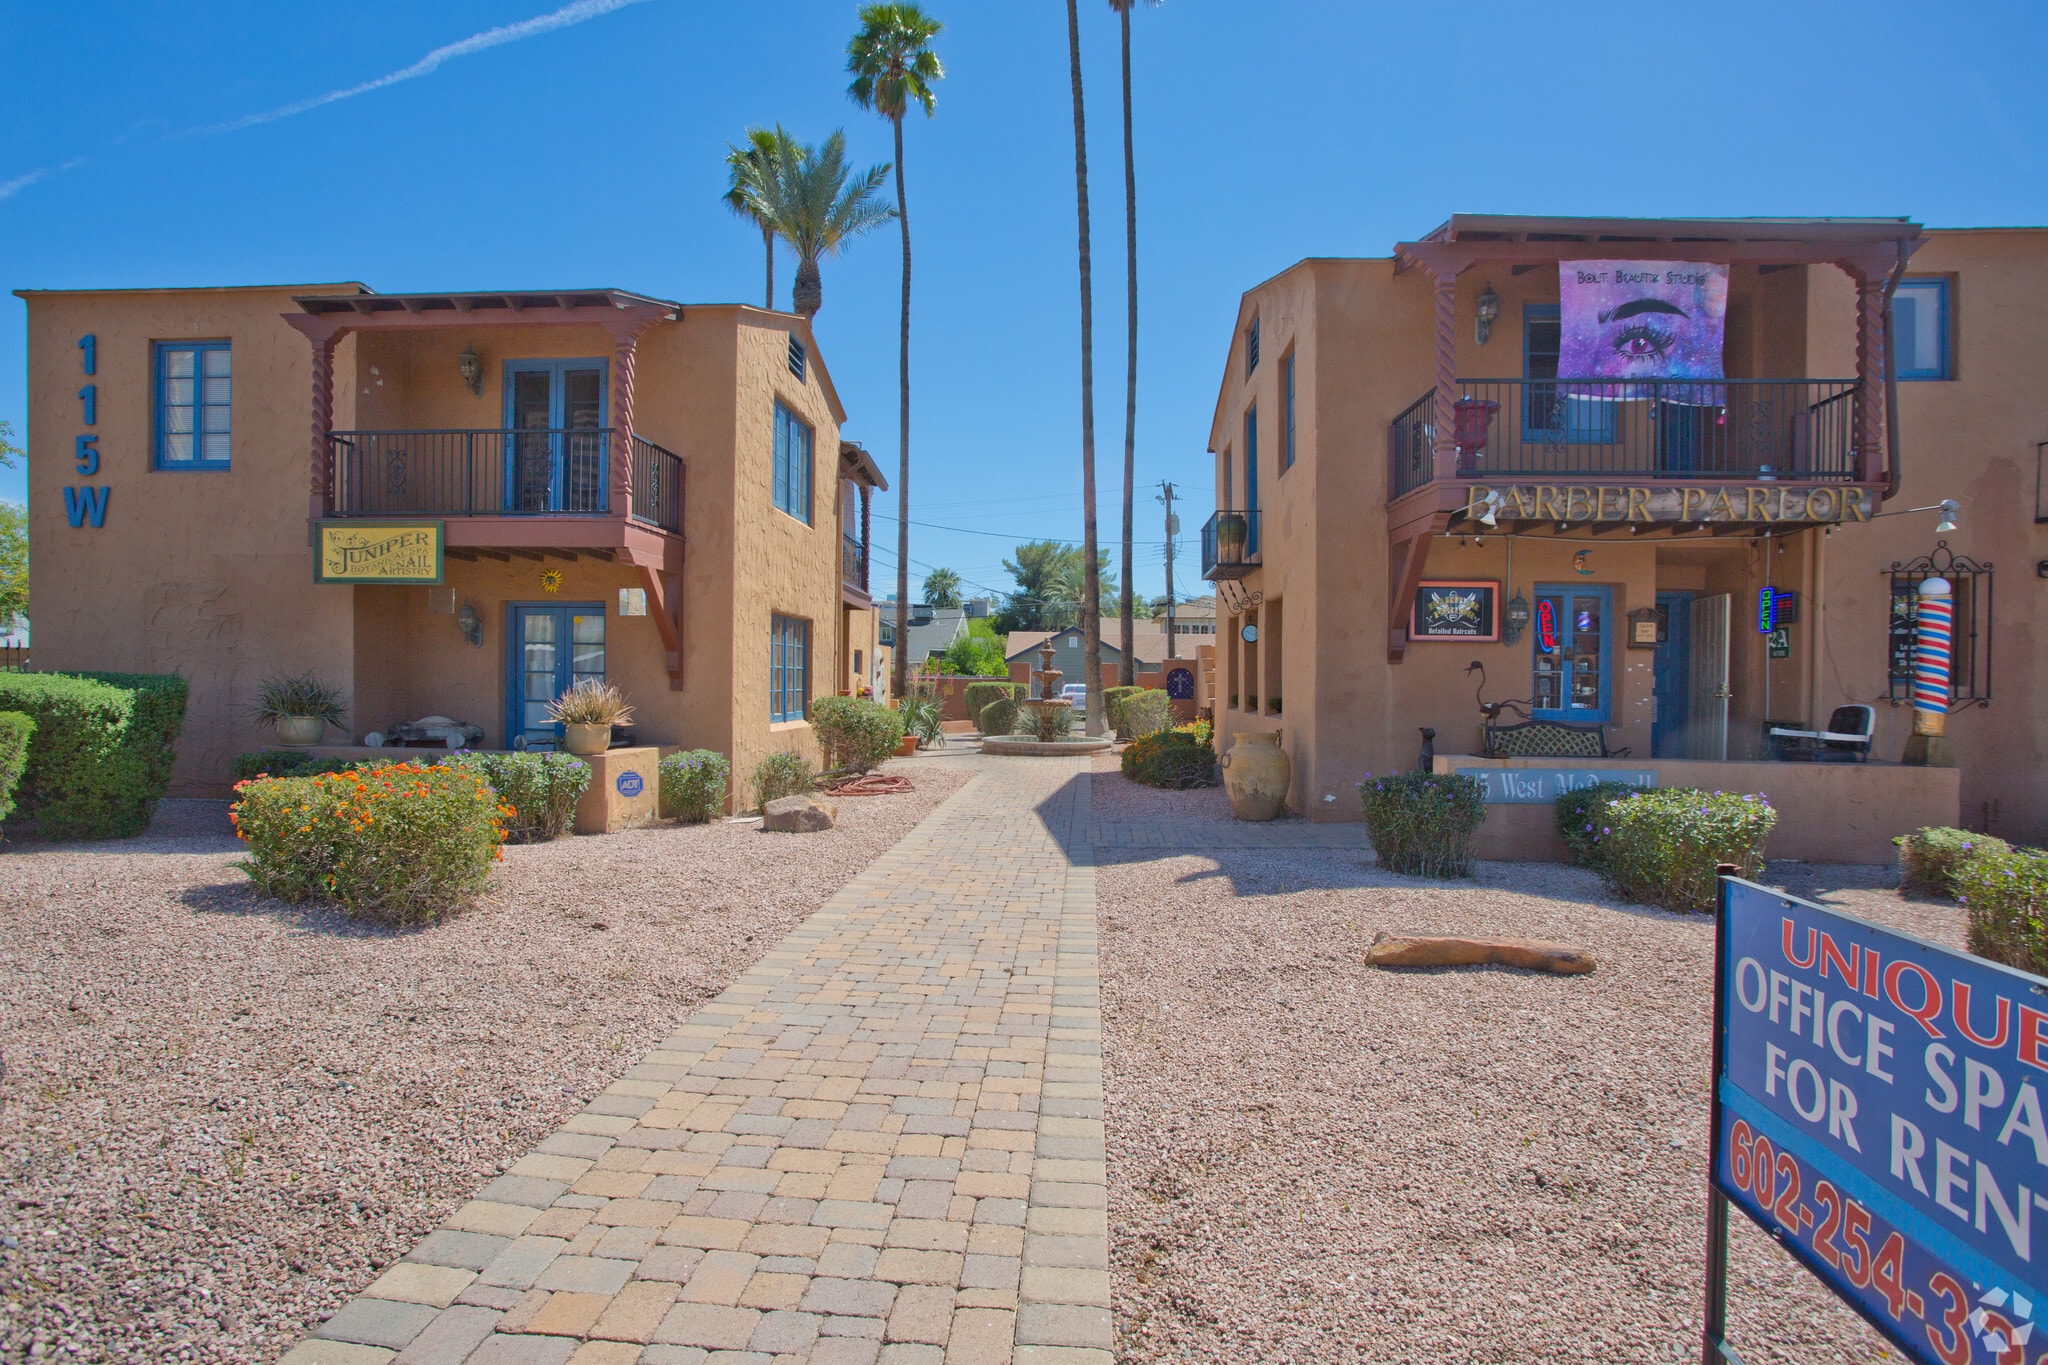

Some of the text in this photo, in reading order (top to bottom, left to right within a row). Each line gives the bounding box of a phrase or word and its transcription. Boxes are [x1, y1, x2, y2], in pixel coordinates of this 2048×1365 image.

[1464, 484, 1867, 523] BARBER PARLOR
[331, 532, 429, 575] JUNIPER
[350, 546, 429, 574] BOTANICAL SPA
[379, 566, 432, 576] ARTISTRY
[397, 555, 432, 568] NAIL
[1539, 601, 1555, 647] OPEN
[1761, 590, 1771, 630] OPEN
[621, 779, 639, 790] ADT
[1500, 772, 1544, 799] West
[1782, 917, 2048, 1072] UNIQUE
[1735, 957, 1896, 1086] OFFICE
[1765, 1041, 1863, 1154] FOR
